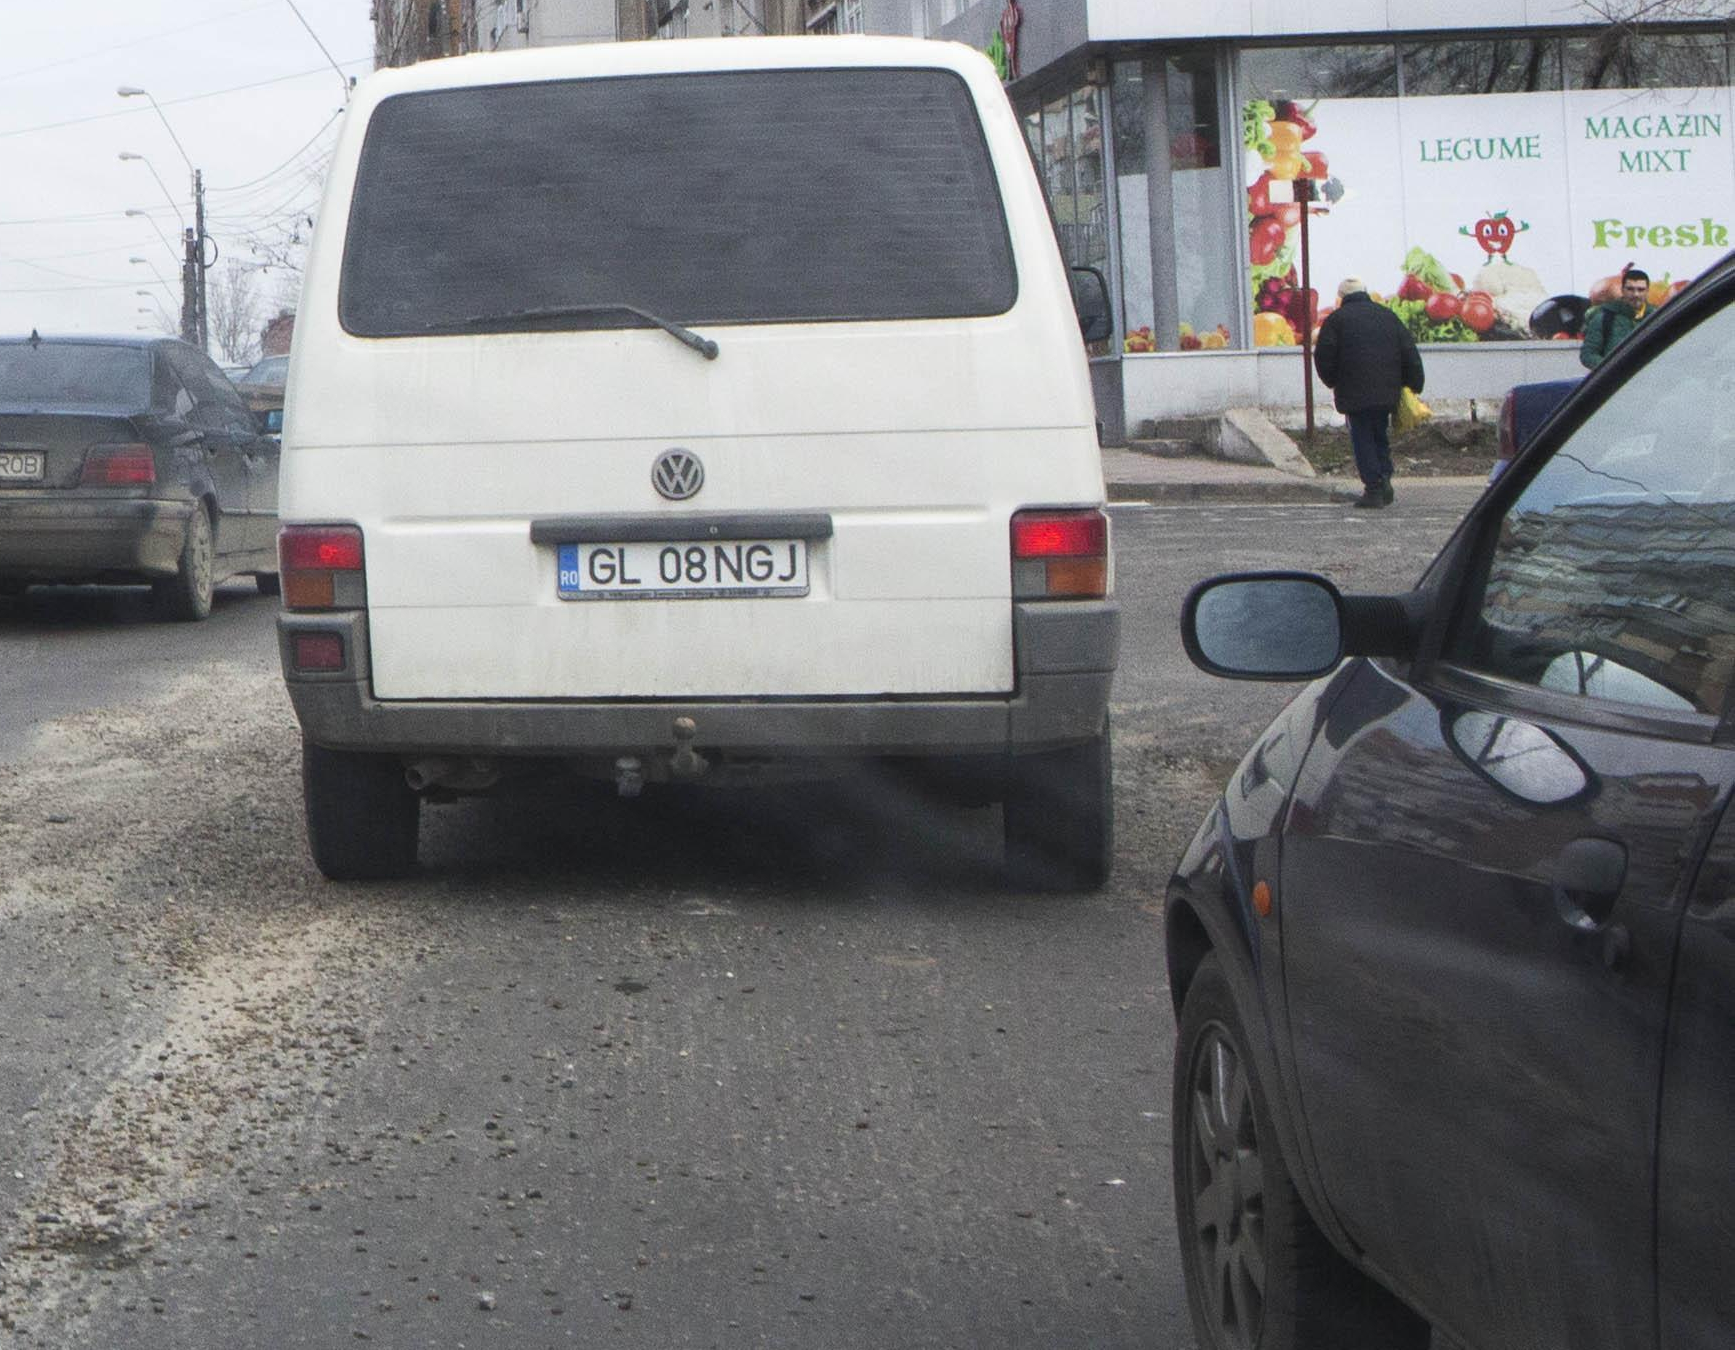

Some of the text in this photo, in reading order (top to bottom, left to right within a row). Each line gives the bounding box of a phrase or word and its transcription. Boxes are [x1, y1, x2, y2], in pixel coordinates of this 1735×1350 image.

[1585, 113, 1722, 140] MAGAZIN
[1419, 135, 1542, 163] LEGUME
[1618, 149, 1692, 173] MIXT
[1592, 217, 1729, 250] Fresh
[560, 570, 578, 586] RO
[588, 548, 641, 585] GL
